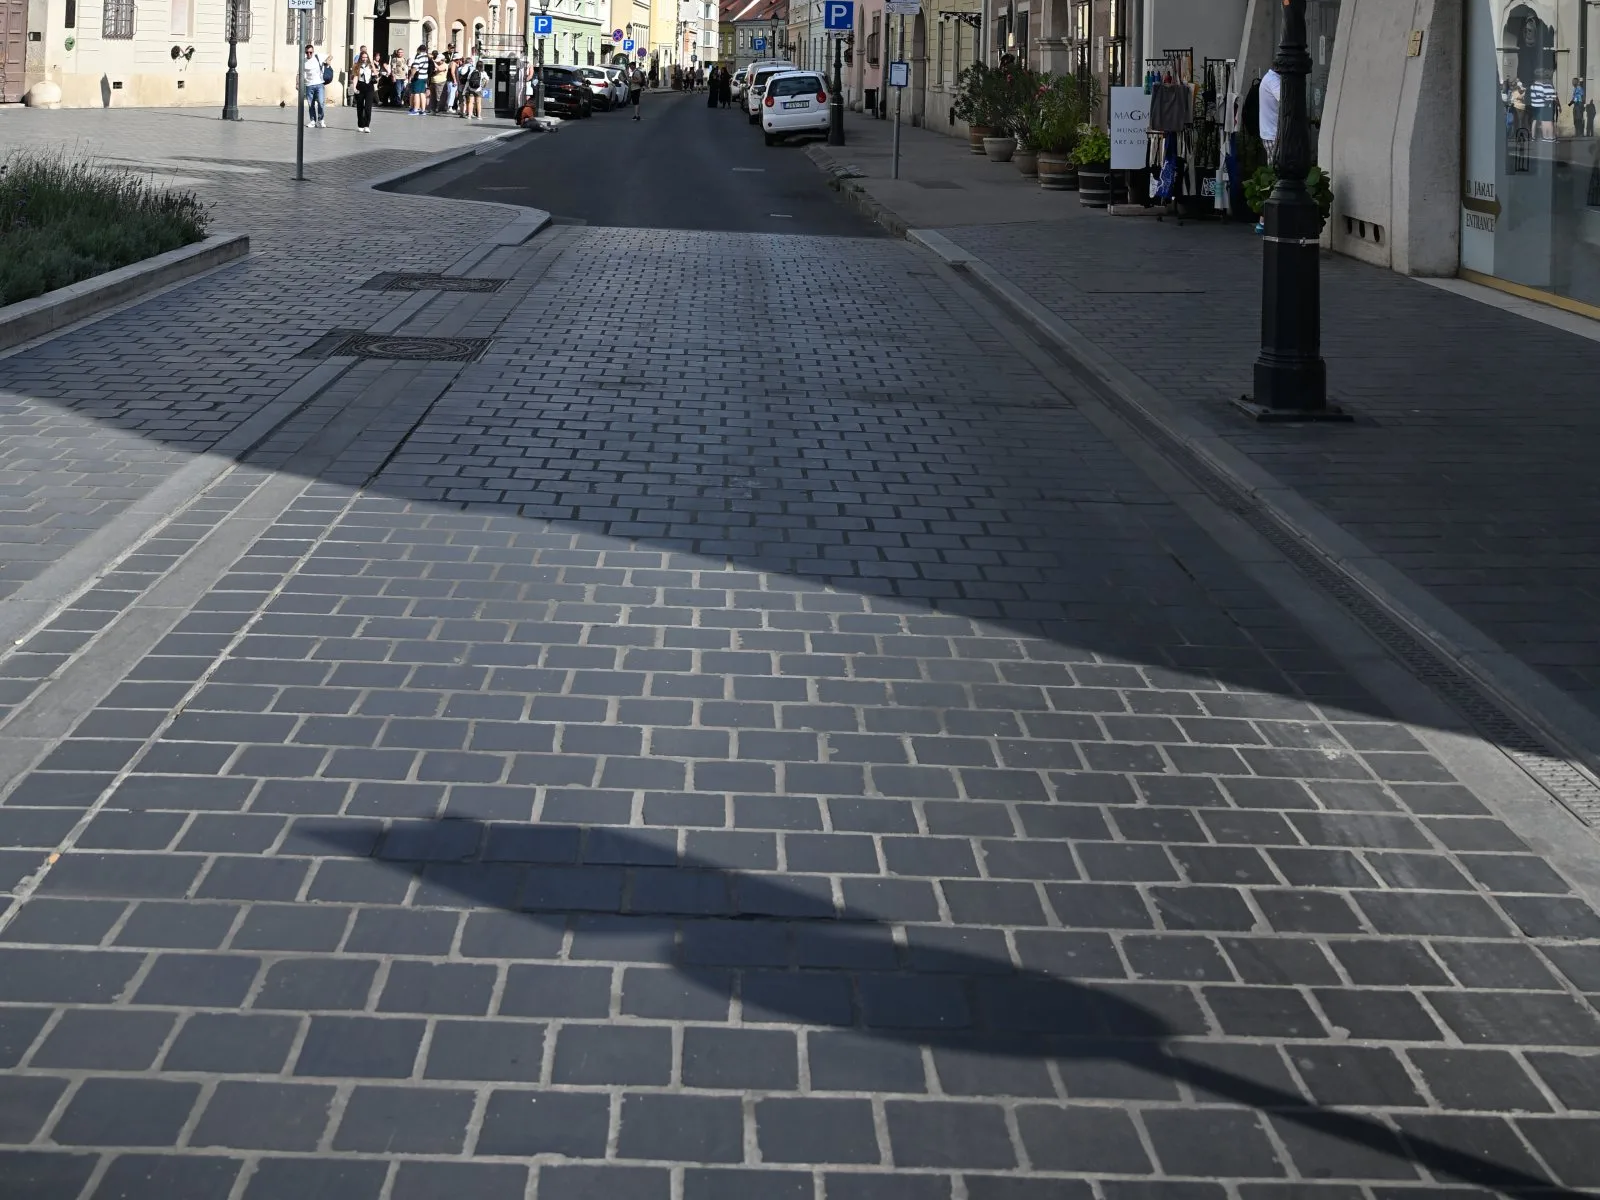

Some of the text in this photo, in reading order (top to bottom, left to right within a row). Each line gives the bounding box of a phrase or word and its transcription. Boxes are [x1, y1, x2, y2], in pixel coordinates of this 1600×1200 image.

[831, 5, 847, 25] P
[538, 19, 548, 31] P
[625, 41, 632, 49] P
[756, 40, 763, 49] P
[1114, 110, 1149, 121] MAGM
[1465, 213, 1495, 233] ENTRANCE
